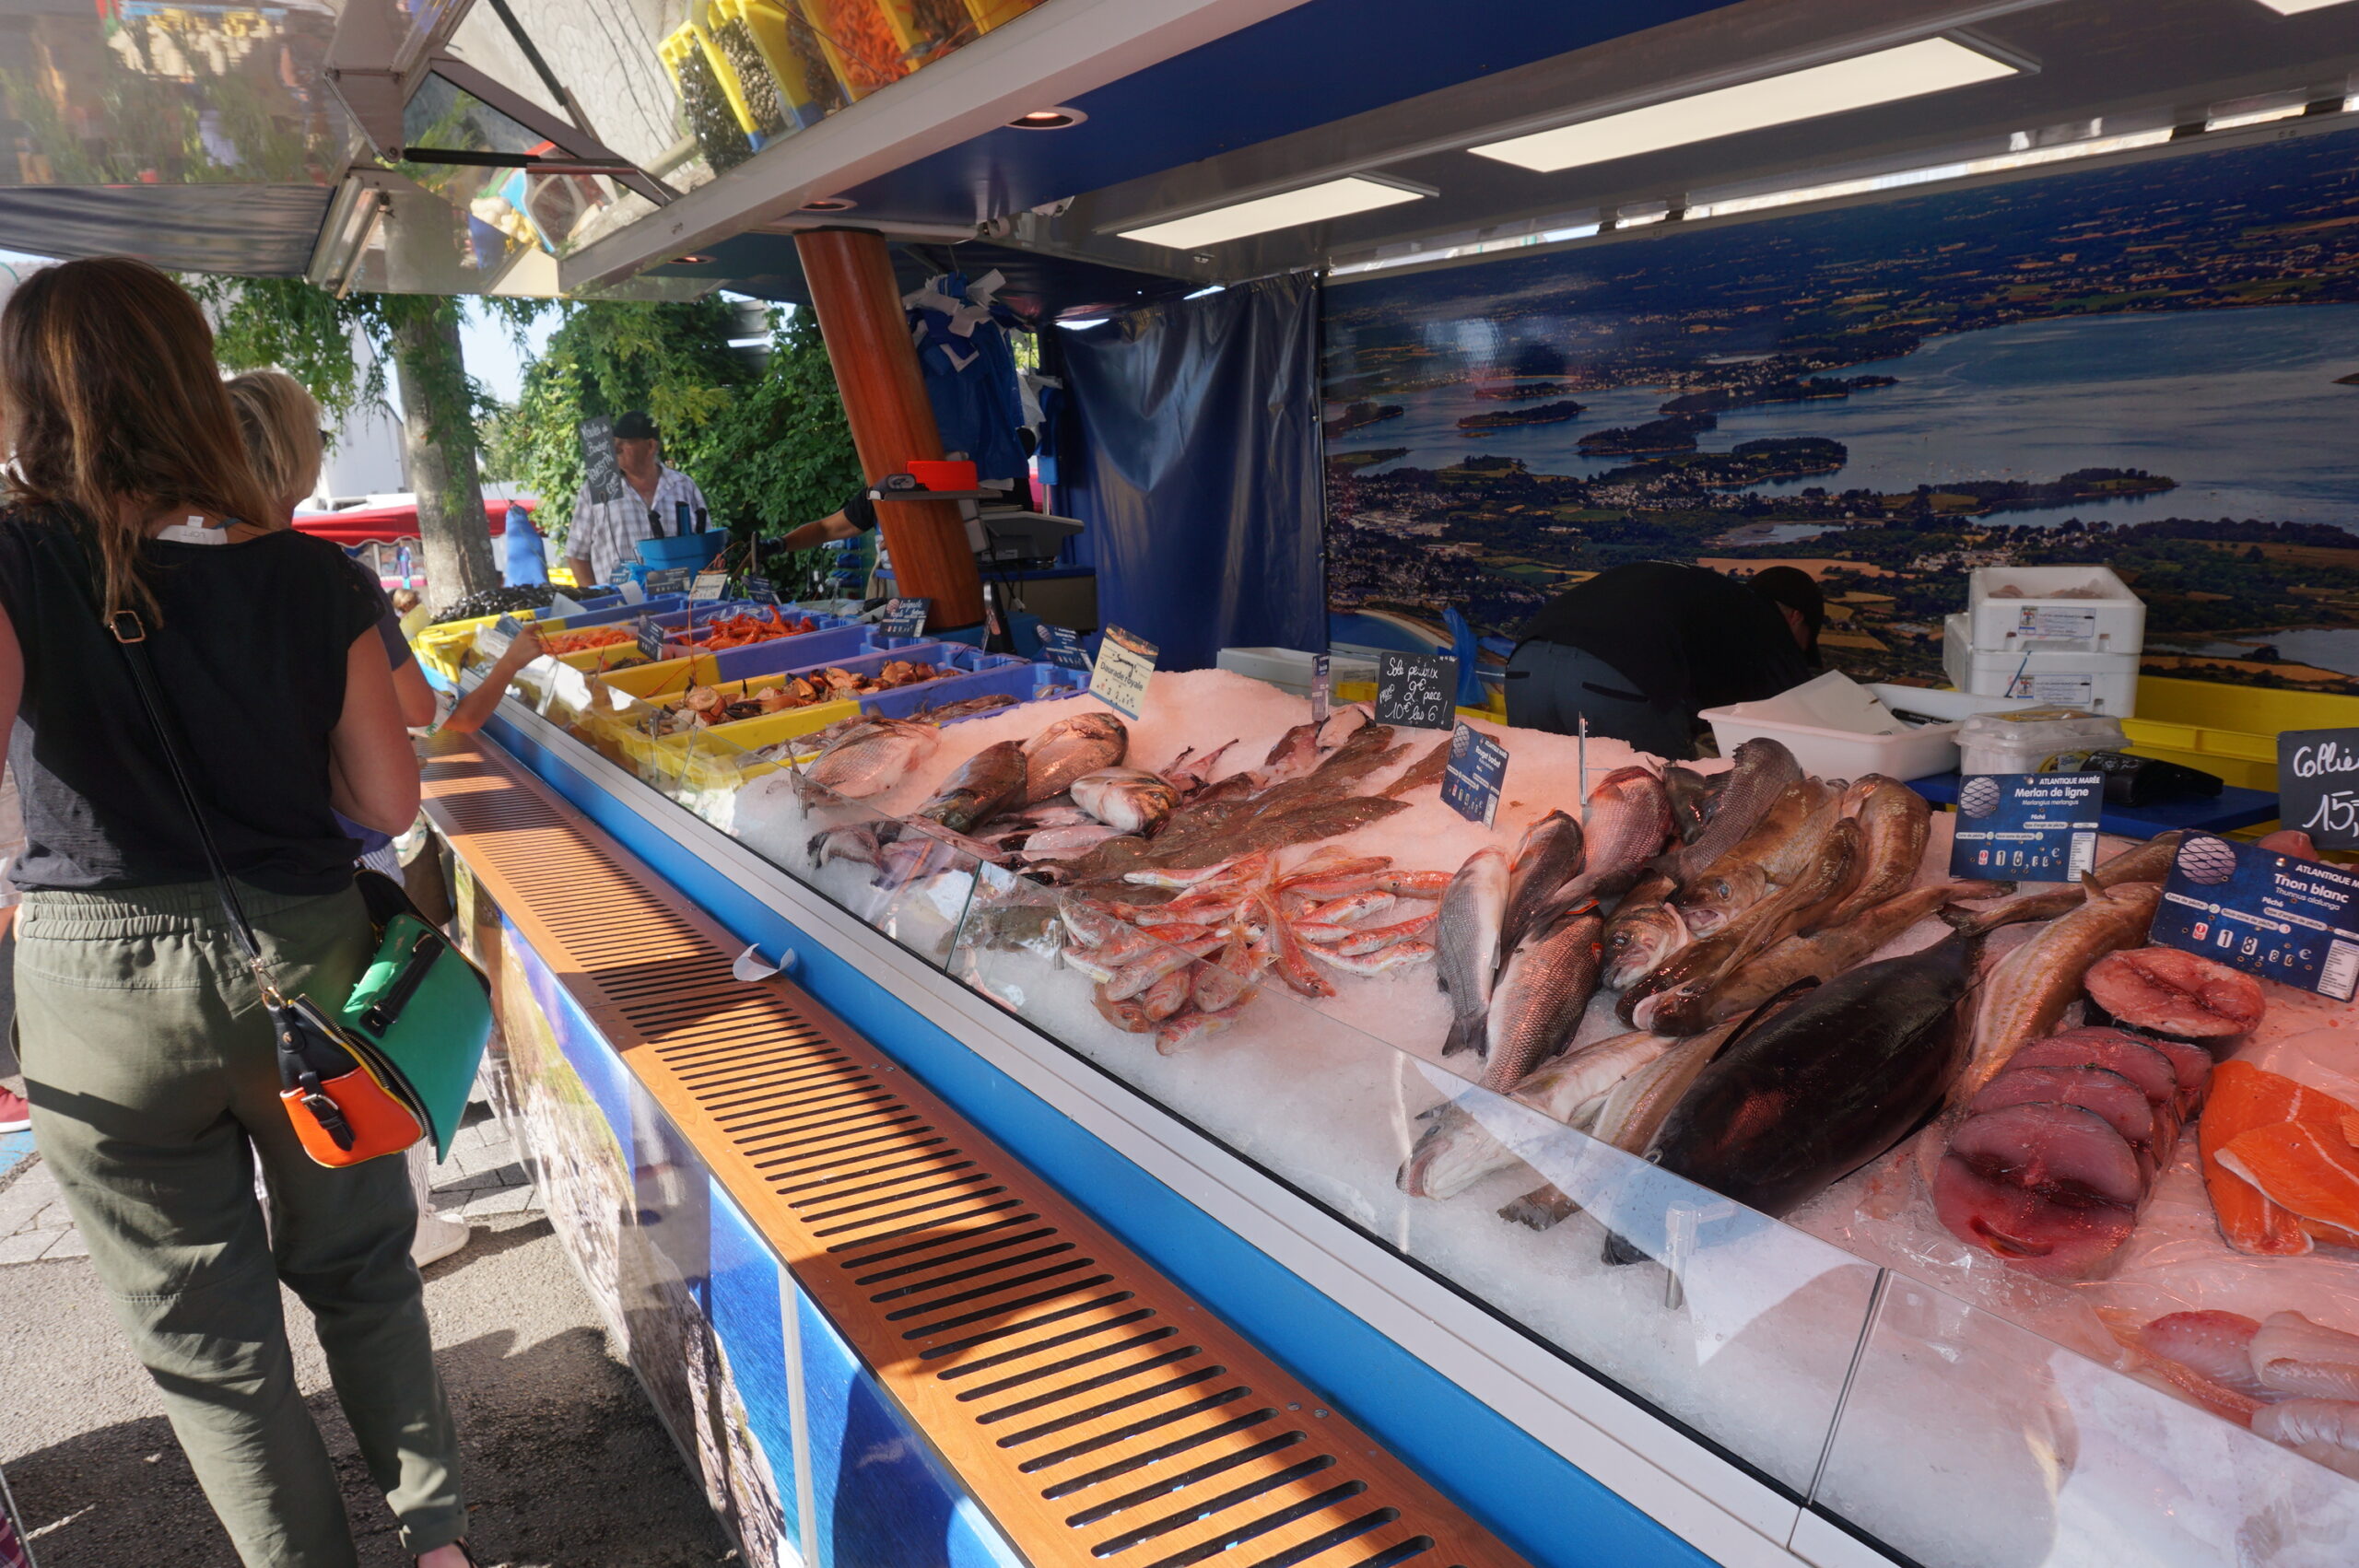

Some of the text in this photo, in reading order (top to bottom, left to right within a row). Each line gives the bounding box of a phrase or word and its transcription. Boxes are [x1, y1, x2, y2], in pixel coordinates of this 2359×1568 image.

[1100, 661, 1144, 692] Daurade royale
[1387, 657, 1404, 676] Sole
[2293, 742, 2359, 778] Collie
[2039, 775, 2101, 785] ATLANTIQUE MARÉE
[2014, 787, 2089, 799] Merlan de ligne
[2294, 864, 2352, 885] ATLANTIQUE
[2261, 896, 2284, 907] Pêché
[2275, 886, 2341, 911] Thunnus alalunga
[2310, 883, 2349, 903] blanc
